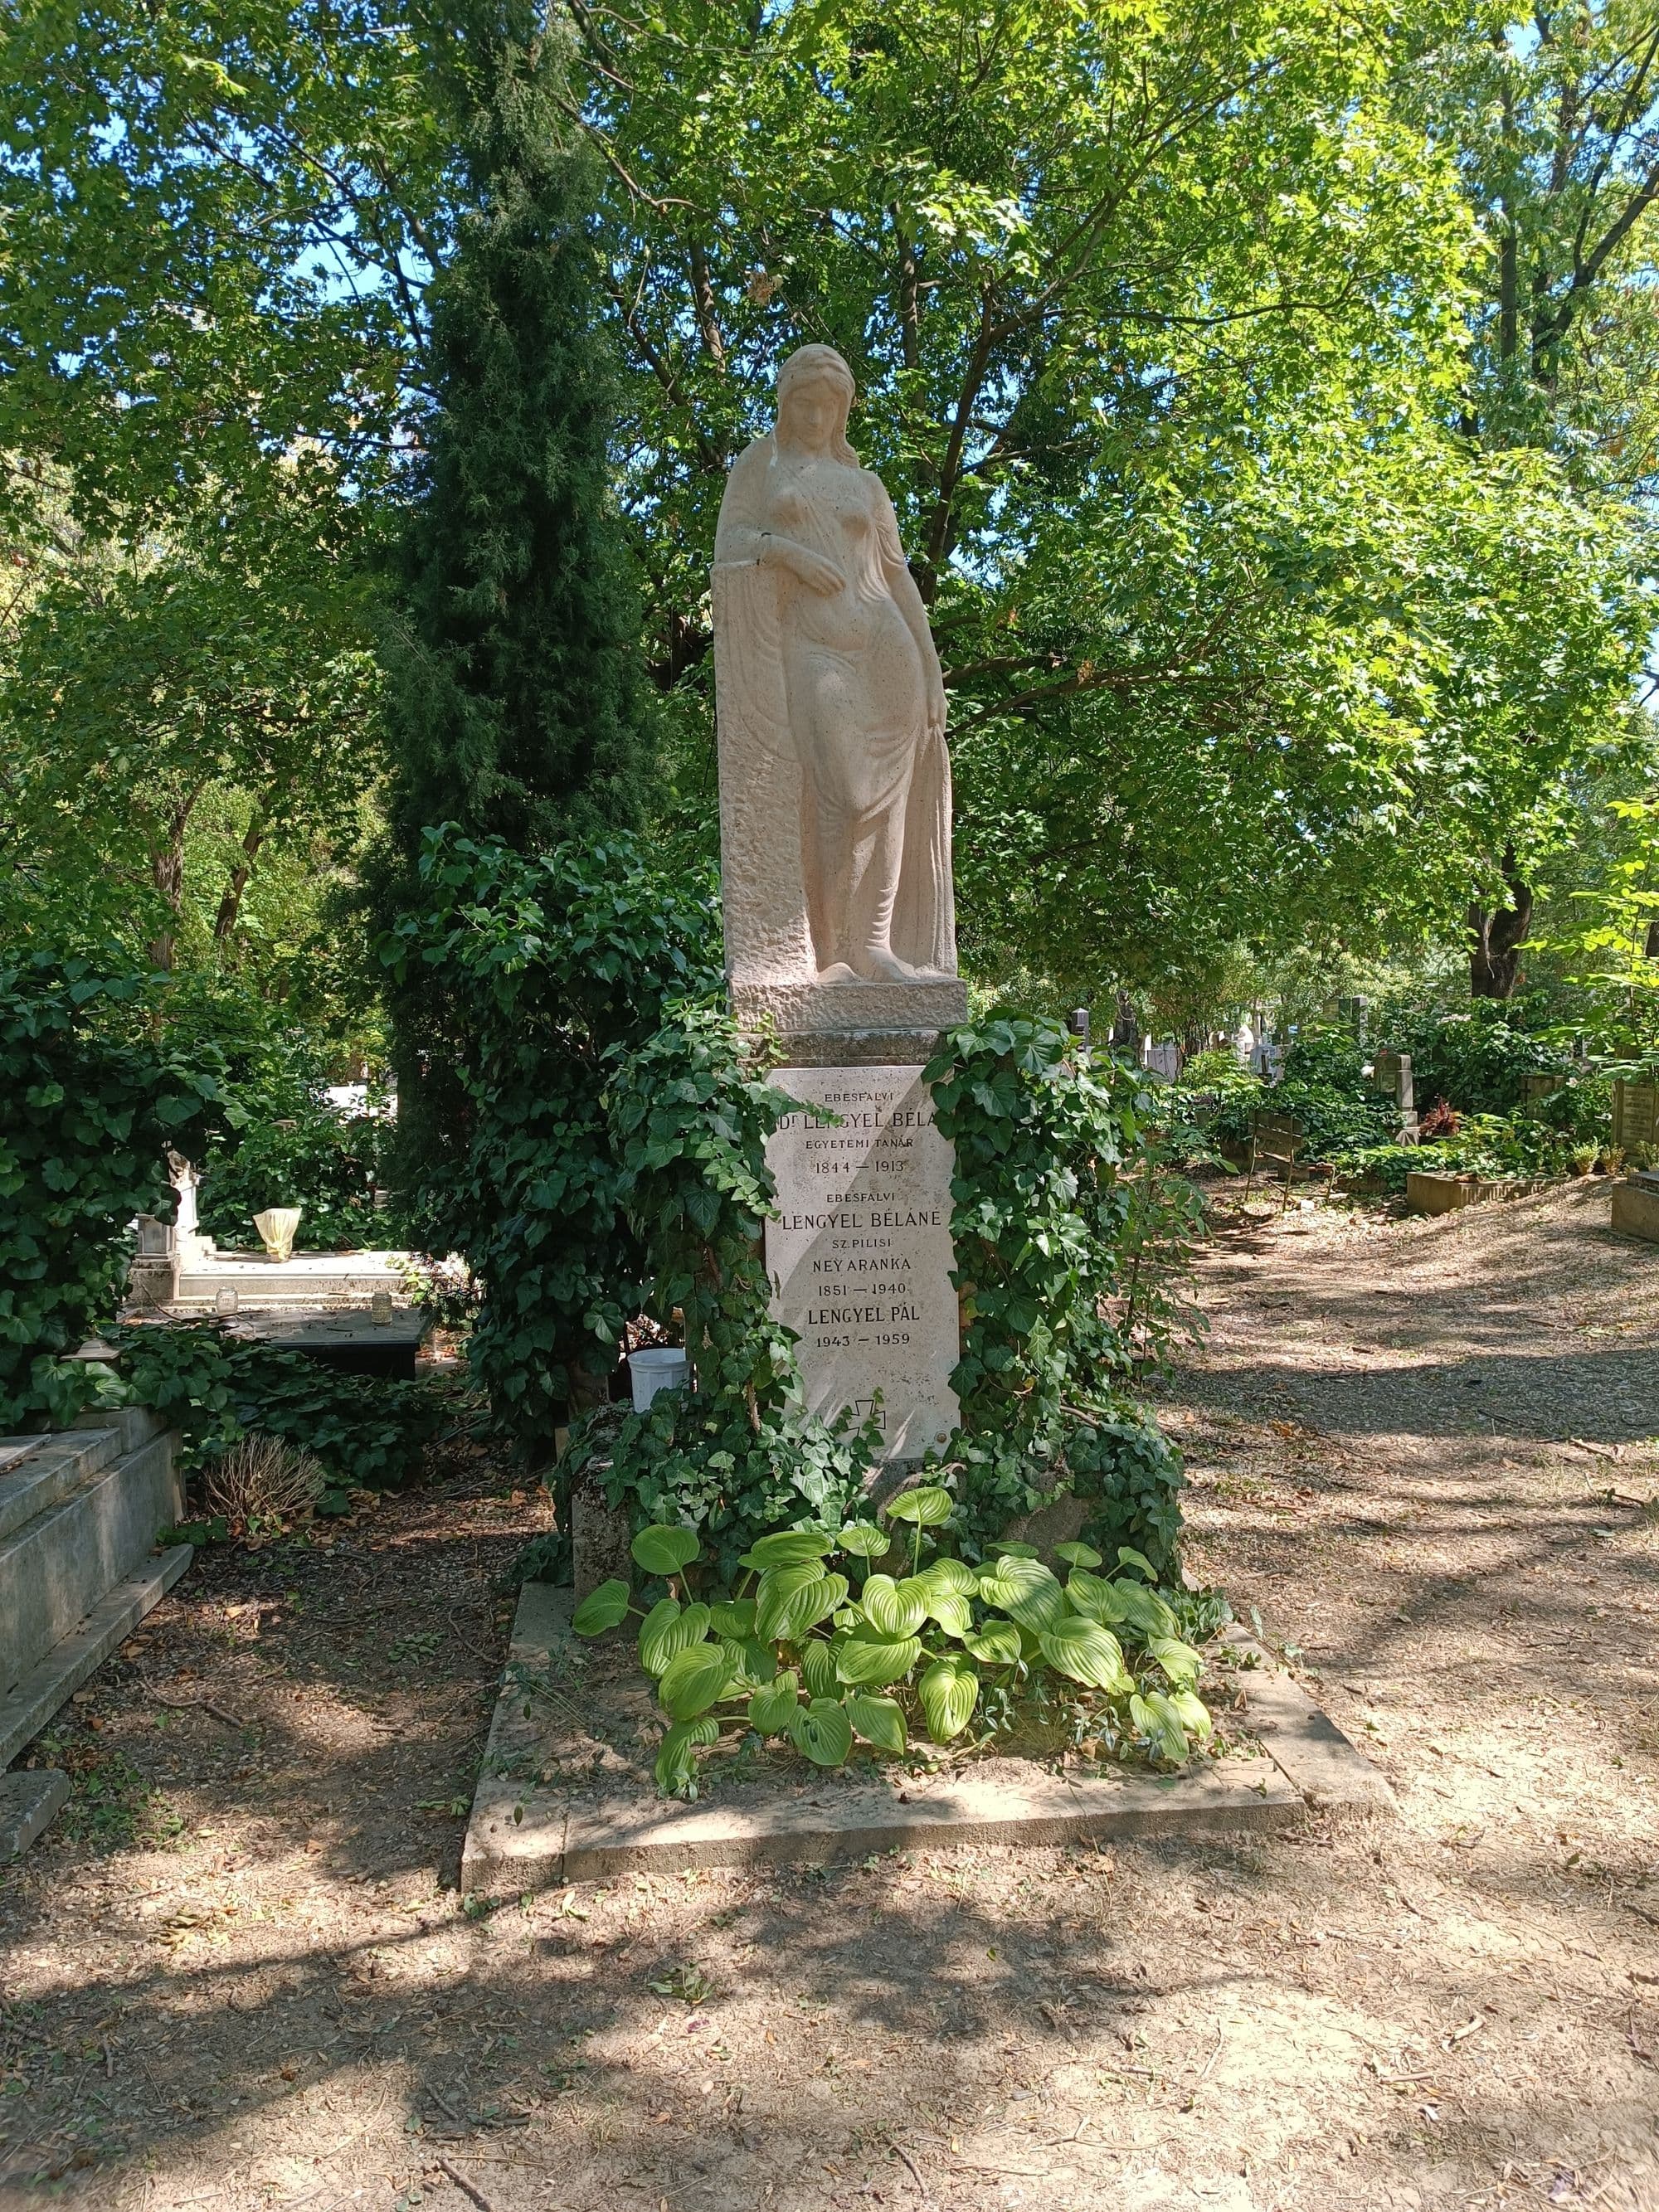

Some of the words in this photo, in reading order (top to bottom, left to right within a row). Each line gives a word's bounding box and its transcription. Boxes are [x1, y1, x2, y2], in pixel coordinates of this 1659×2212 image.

[825, 1092, 893, 1101] EBESFALVI
[805, 1140, 869, 1149] EGYETEMI
[815, 1162, 850, 1174] 1844
[875, 1160, 903, 1172] 1913
[826, 1193, 895, 1203] EBESFALVI
[782, 1213, 863, 1230] LENGYEL
[813, 1260, 843, 1272] NEY
[846, 1258, 911, 1271] ARANKA
[818, 1286, 847, 1296] 1851
[872, 1283, 906, 1295] 1940
[808, 1308, 885, 1325] LENGYEL
[817, 1336, 850, 1347] 1943
[877, 1333, 910, 1344] 1959
